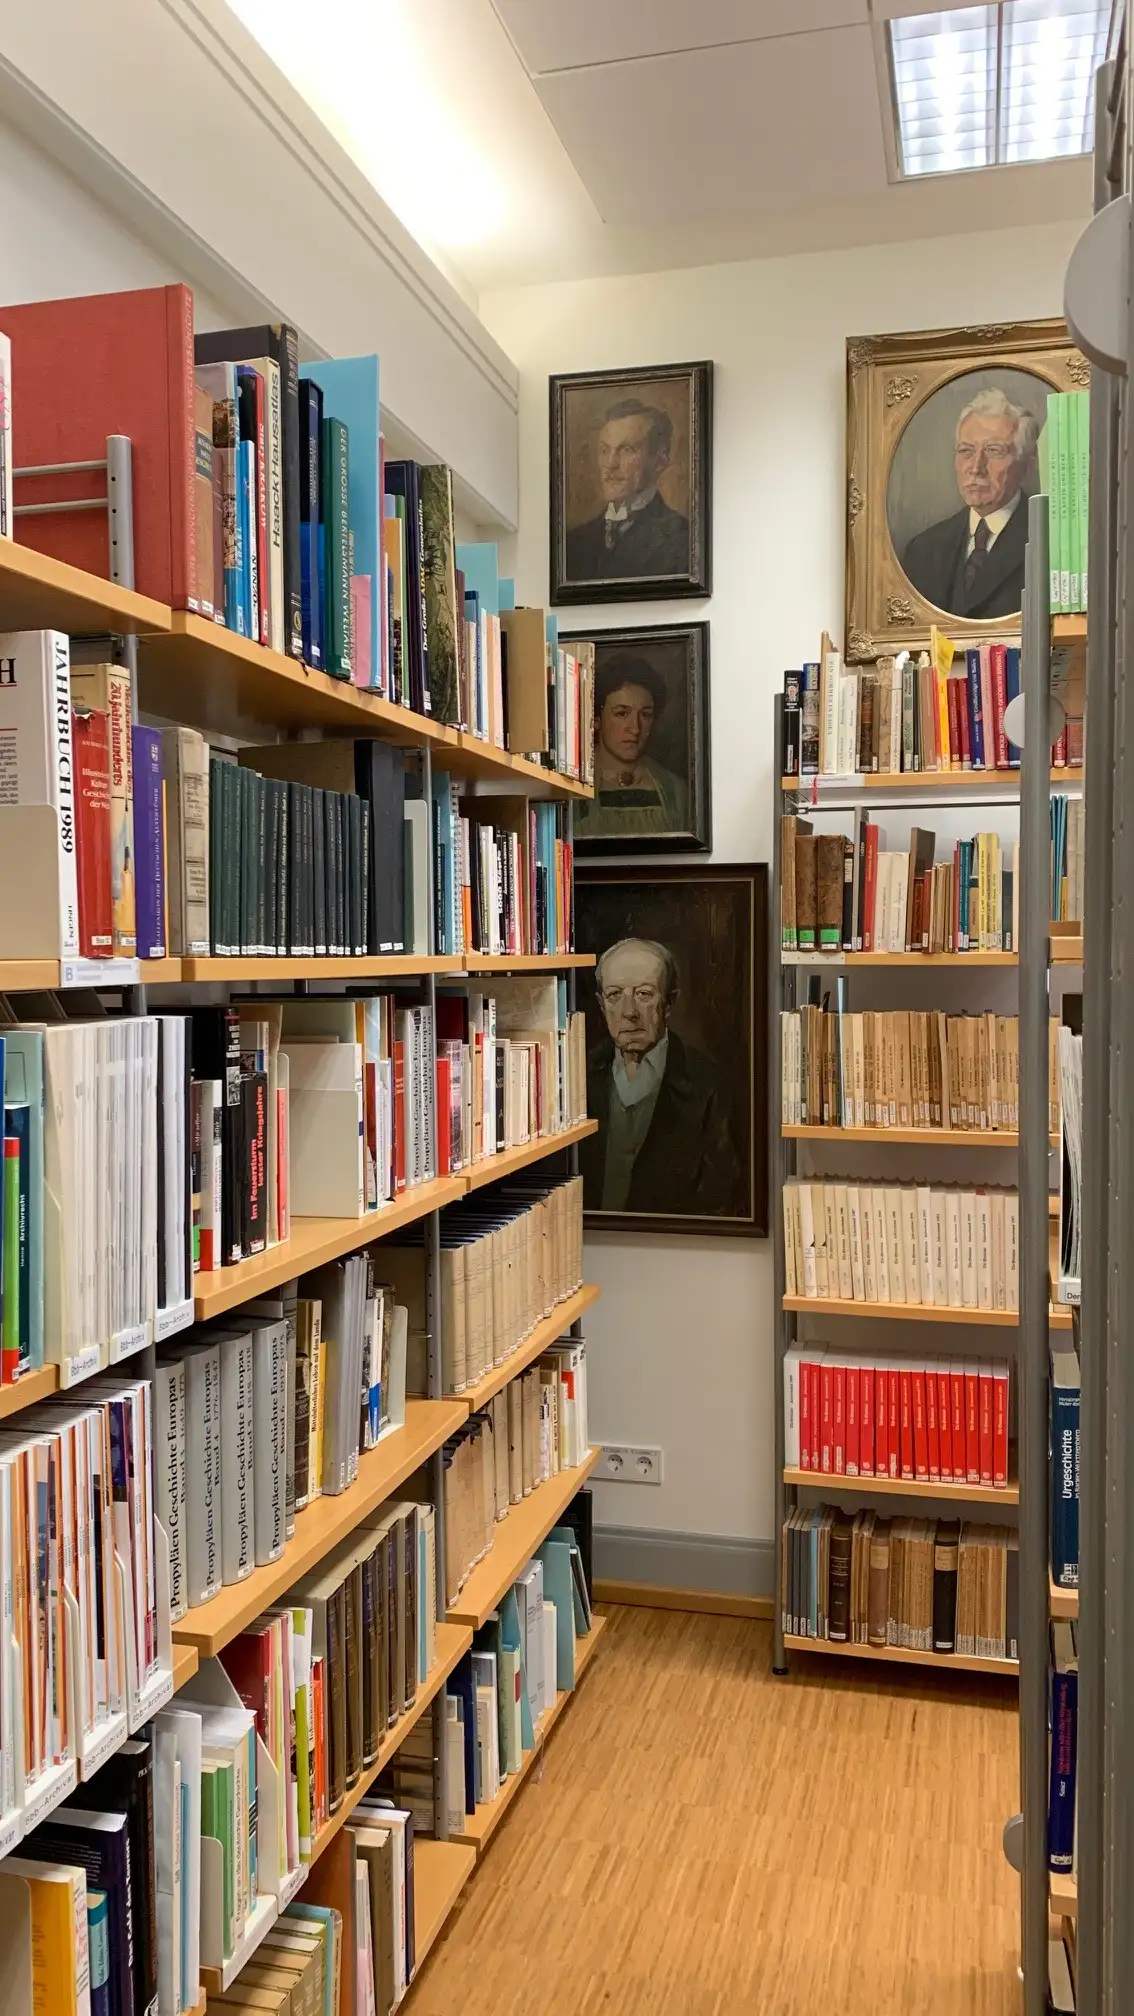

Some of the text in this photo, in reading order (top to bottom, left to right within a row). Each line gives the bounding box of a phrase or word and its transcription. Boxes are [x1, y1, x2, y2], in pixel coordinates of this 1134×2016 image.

[270, 372, 281, 548] Haack Hausatlas
[340, 428, 348, 452] DER
[341, 456, 349, 506] GROSSE
[341, 509, 350, 600] BERTELSMANN
[55, 641, 74, 854] JAHRBUCH 1989
[65, 966, 74, 981] B
[421, 1015, 429, 1061] Europas
[257, 1085, 265, 1148] Kriegsjahre
[249, 1139, 257, 1220] Im Feuersturm
[269, 1337, 281, 1549] Propyläen Geschichte Europas
[310, 1383, 318, 1433] Mittelalterliches
[166, 1376, 181, 1608] Propyläen Geschichte Europas
[202, 1362, 216, 1587] Propyläen Geschichte Europas
[235, 1349, 249, 1567] Propyläen Geschichte Europas
[1062, 1429, 1073, 1499] Urgeschichte
[234, 1768, 243, 1818] Geschichte
